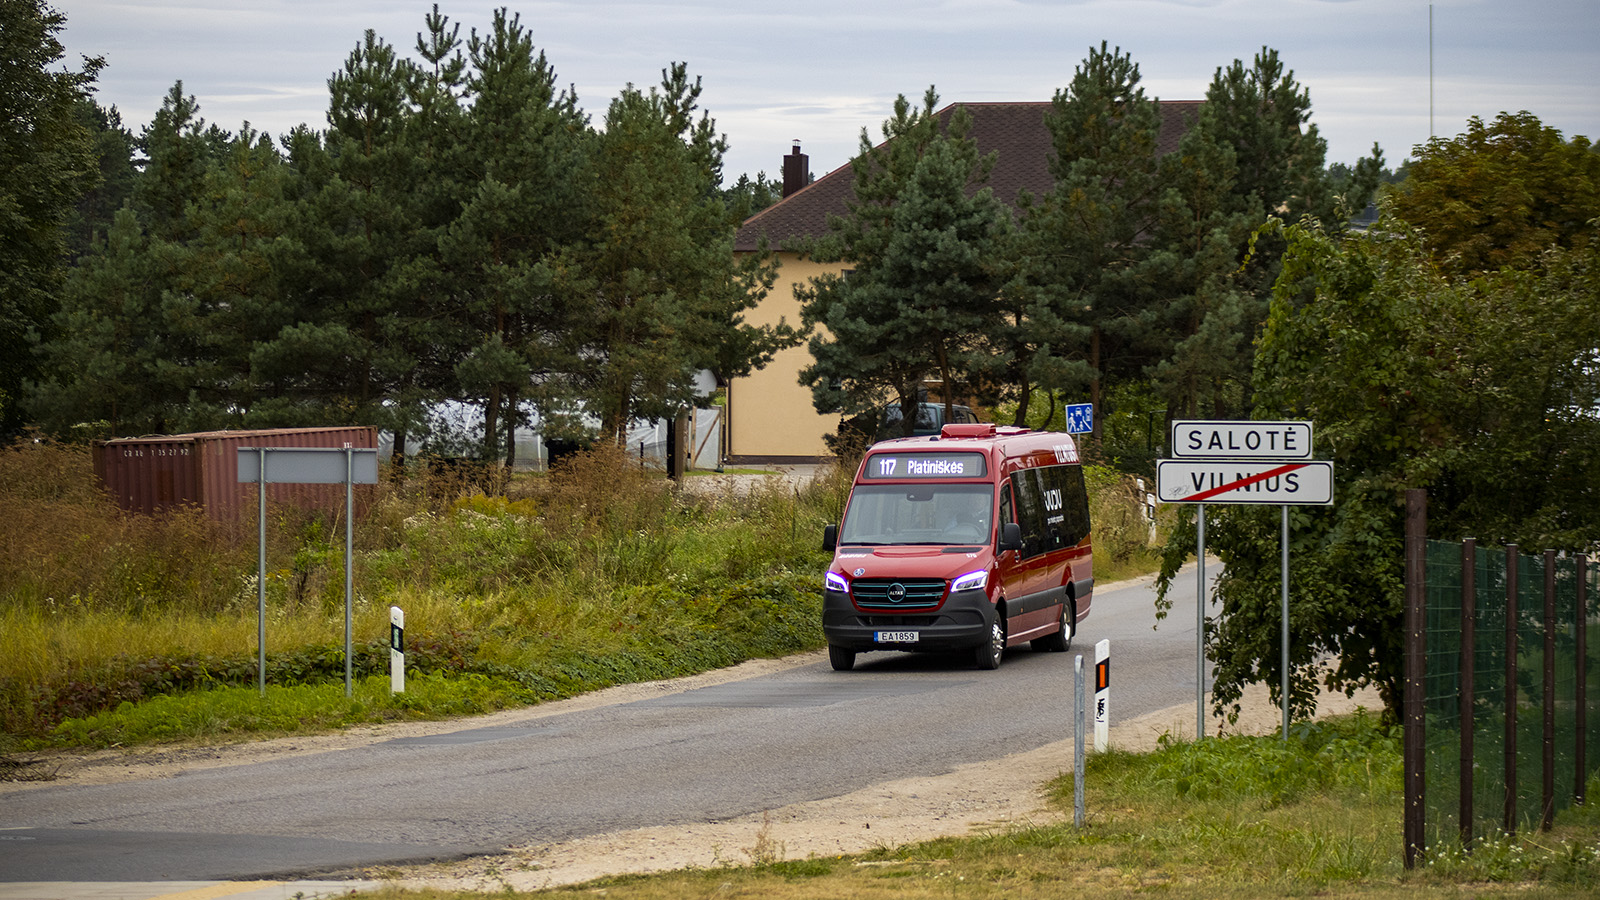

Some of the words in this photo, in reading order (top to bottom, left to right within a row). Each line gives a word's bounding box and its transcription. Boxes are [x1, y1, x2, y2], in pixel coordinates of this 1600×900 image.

[1188, 427, 1297, 450] SALOTĖ
[880, 459, 897, 475] 117
[907, 459, 964, 474] Platiniškės
[1191, 472, 1299, 493] VILNIUS
[1043, 489, 1063, 512] JUDU
[882, 632, 915, 641] EA1859
